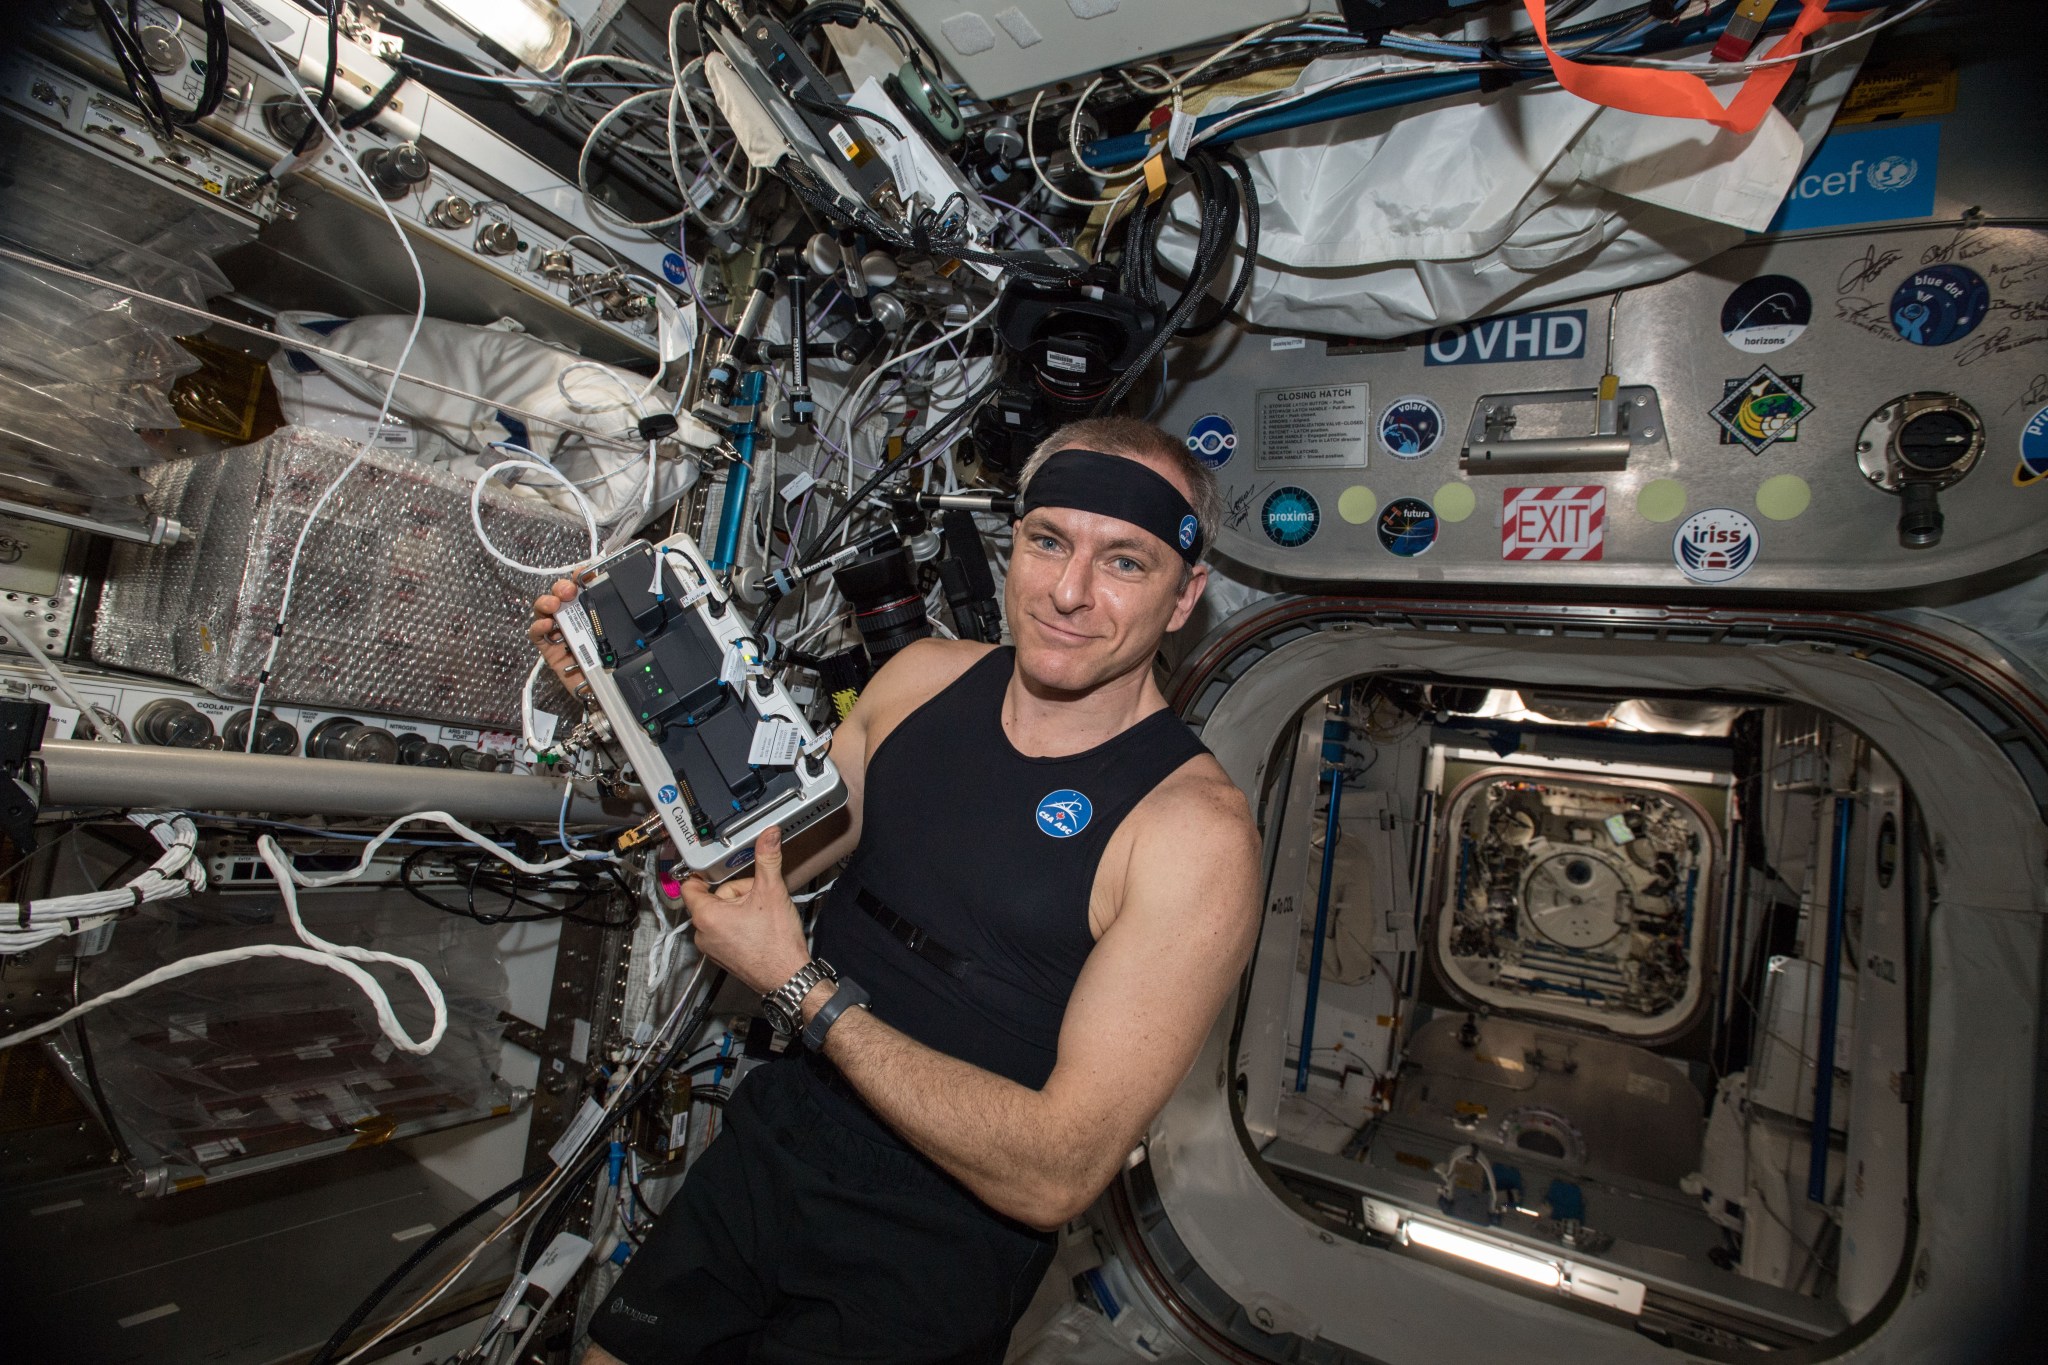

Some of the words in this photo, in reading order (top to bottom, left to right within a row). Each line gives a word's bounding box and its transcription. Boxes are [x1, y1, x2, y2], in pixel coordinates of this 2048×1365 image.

[1914, 274, 1944, 287] blue
[1944, 282, 1964, 299] dot
[1429, 315, 1584, 364] OVHD
[1744, 336, 1786, 346] horizons
[792, 337, 801, 386] Manfrotto
[1277, 391, 1317, 401] CLOSING
[1319, 388, 1352, 398] HATCH
[1398, 401, 1428, 413] volare
[1269, 511, 1315, 525] proxima
[1403, 508, 1431, 518] futura
[1517, 504, 1590, 543] EXIT
[1692, 525, 1742, 544] iriss
[197, 701, 235, 712] COOLANT
[389, 723, 418, 732] NITROGEN
[671, 806, 697, 847] Canada
[1038, 810, 1055, 824] CSA
[1054, 821, 1073, 836] ASC
